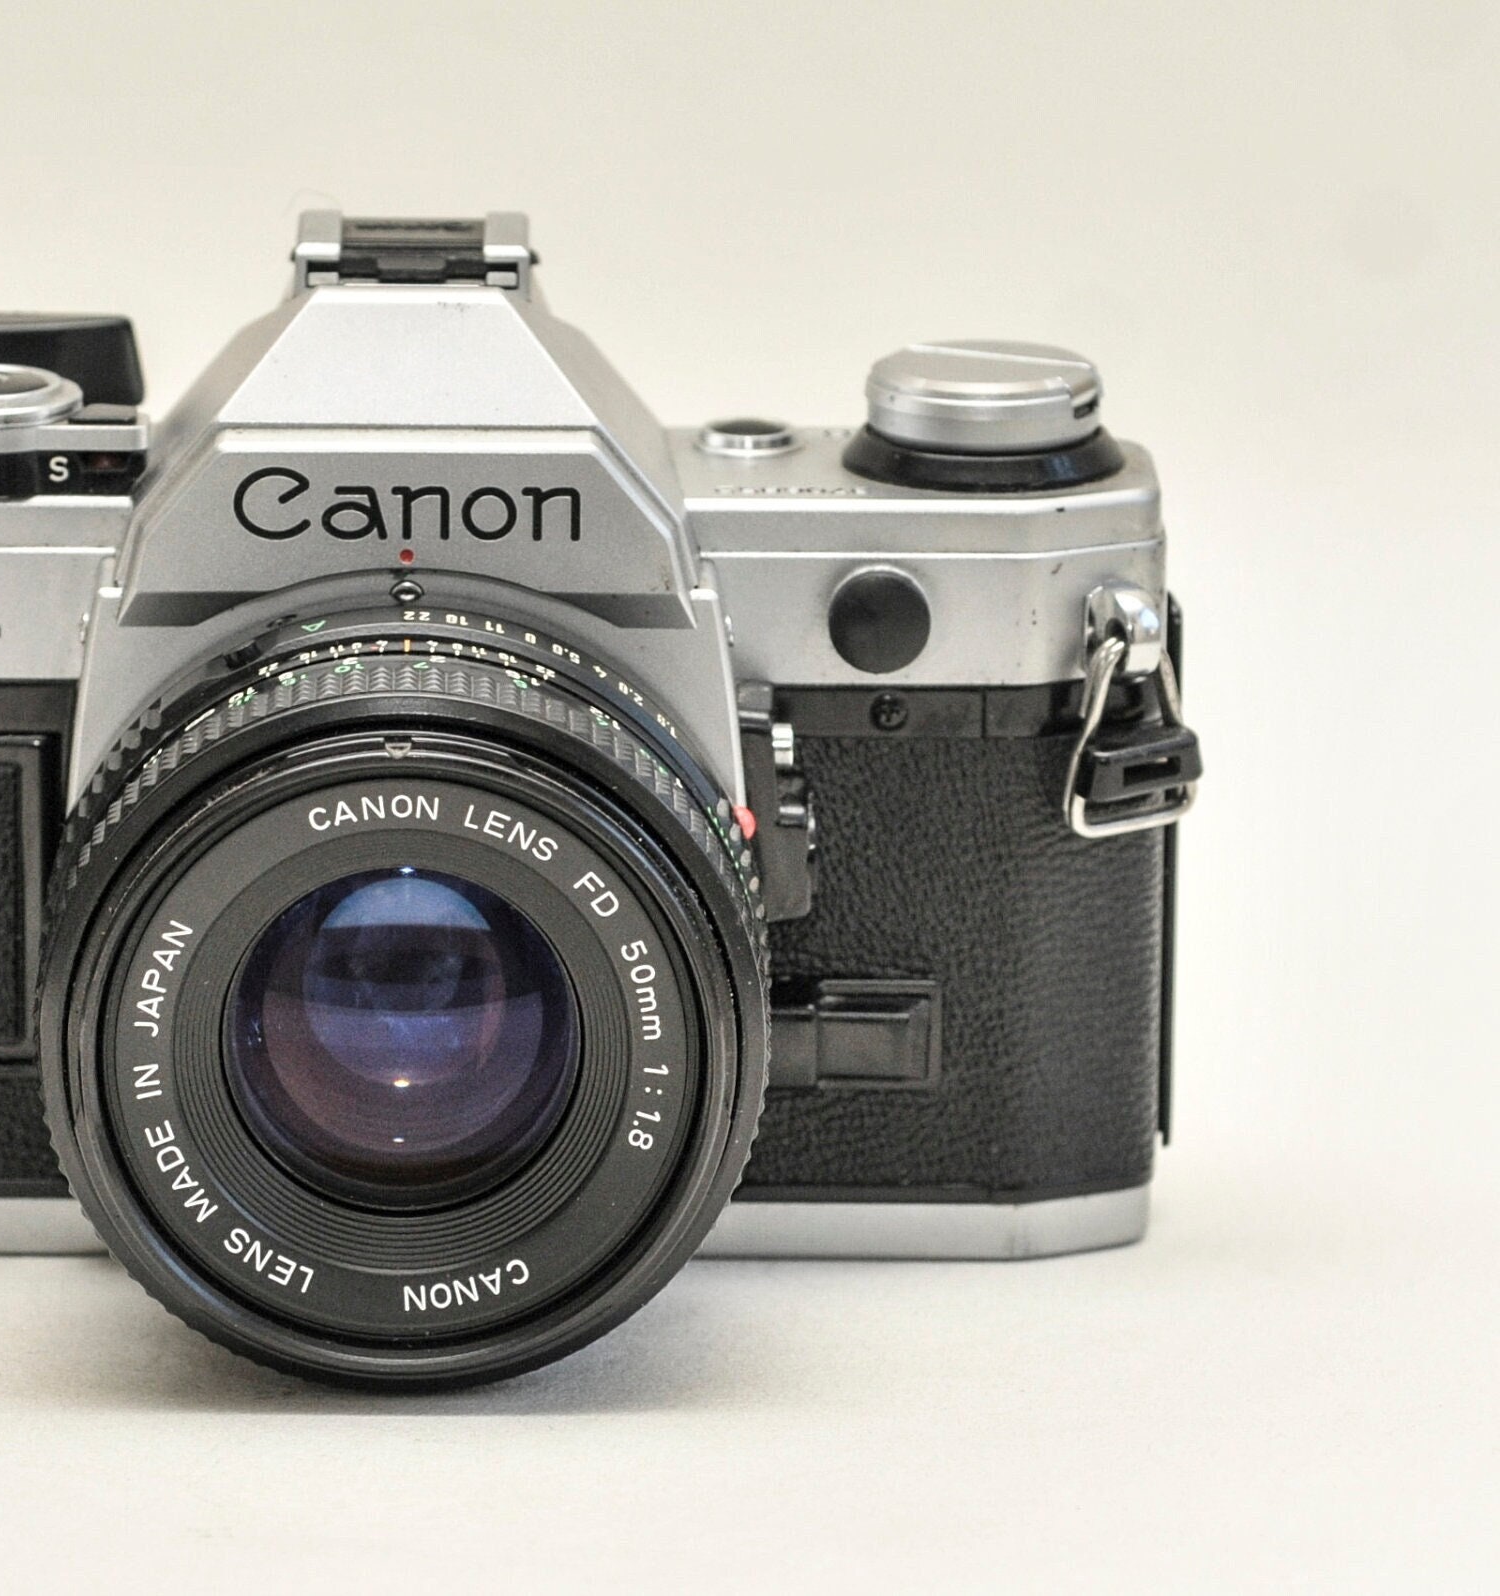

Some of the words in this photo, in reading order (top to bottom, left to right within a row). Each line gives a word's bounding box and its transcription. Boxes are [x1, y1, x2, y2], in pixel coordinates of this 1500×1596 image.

[47, 457, 69, 482] S
[233, 466, 580, 541] Canon
[301, 620, 326, 632] A
[403, 611, 430, 621] 22
[309, 795, 441, 832] CANON
[464, 805, 560, 863] LENS
[573, 872, 621, 919] FD
[621, 941, 663, 1042] 50mm
[134, 920, 195, 1039] JAPAN
[133, 1064, 164, 1101] IN
[144, 1120, 220, 1224] MADE
[224, 1229, 315, 1294] LENS
[404, 1260, 530, 1313] CANON
